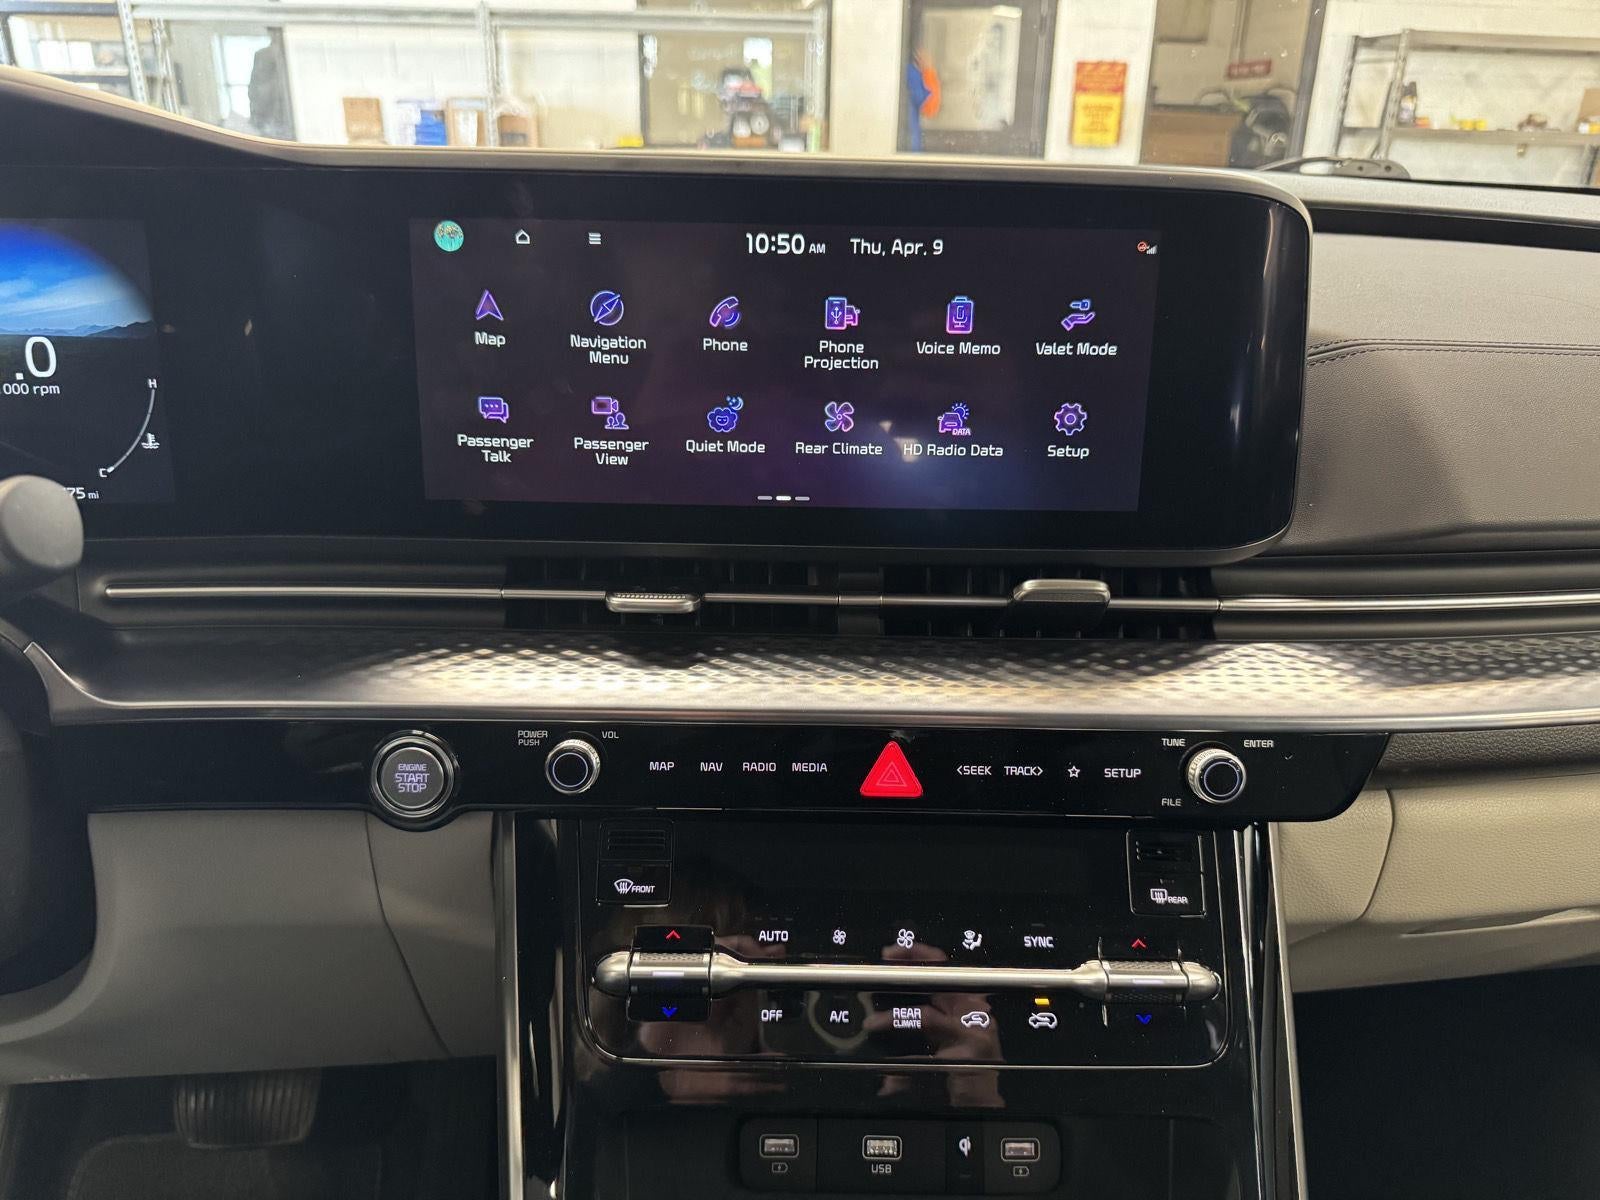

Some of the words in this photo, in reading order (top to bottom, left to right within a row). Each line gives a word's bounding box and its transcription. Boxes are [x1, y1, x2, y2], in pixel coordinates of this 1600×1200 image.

[746, 233, 804, 254] 10:50
[808, 243, 826, 254] AM
[850, 239, 885, 256] Thu,
[892, 239, 926, 257] Apr.
[932, 239, 944, 255] 9
[474, 331, 506, 348] Map
[570, 334, 647, 351] Navigation
[703, 337, 748, 352] Phone
[819, 340, 865, 354] Phone
[916, 341, 955, 355] Voice
[958, 341, 1001, 355] Memo
[1035, 342, 1074, 357] Valet
[1076, 342, 1118, 356] Mode
[589, 351, 630, 365] Menu
[804, 355, 879, 371] Projection
[148, 378, 158, 389] H
[32, 385, 61, 397] rpm
[951, 427, 972, 436] DATA
[456, 433, 535, 450] Passenger
[573, 436, 650, 453] Passenger
[685, 439, 724, 454] Quiet
[727, 440, 766, 453] Mode
[795, 441, 829, 455] Rear
[832, 442, 883, 455] Climate
[902, 443, 924, 457] HD
[926, 443, 967, 456] Radio
[970, 444, 1004, 457] Data
[1047, 444, 1090, 460] Setup
[481, 449, 512, 463] Talk
[595, 452, 630, 466] View
[87, 490, 100, 500] mi
[518, 730, 548, 738] POWER
[601, 730, 620, 739] VOL
[1161, 737, 1186, 747] TUNE
[1243, 739, 1274, 748] ENTER
[649, 761, 675, 771] MAP
[700, 761, 723, 772] NAV
[742, 761, 777, 772] RADIO
[791, 762, 828, 773] MEDIA
[395, 772, 429, 783] START
[1104, 767, 1142, 778] SETUP
[398, 783, 427, 793] STOP
[1161, 797, 1182, 807] FILE
[631, 884, 657, 894] FRONT
[1168, 896, 1188, 904] REAR
[758, 930, 789, 942] AUTO
[1023, 935, 1054, 948] SYNC
[760, 1009, 783, 1022] OFF
[829, 1010, 849, 1023] A/C
[893, 1008, 921, 1019] REAR
[893, 1020, 921, 1028] CLIMATE
[871, 1163, 892, 1174] USB
